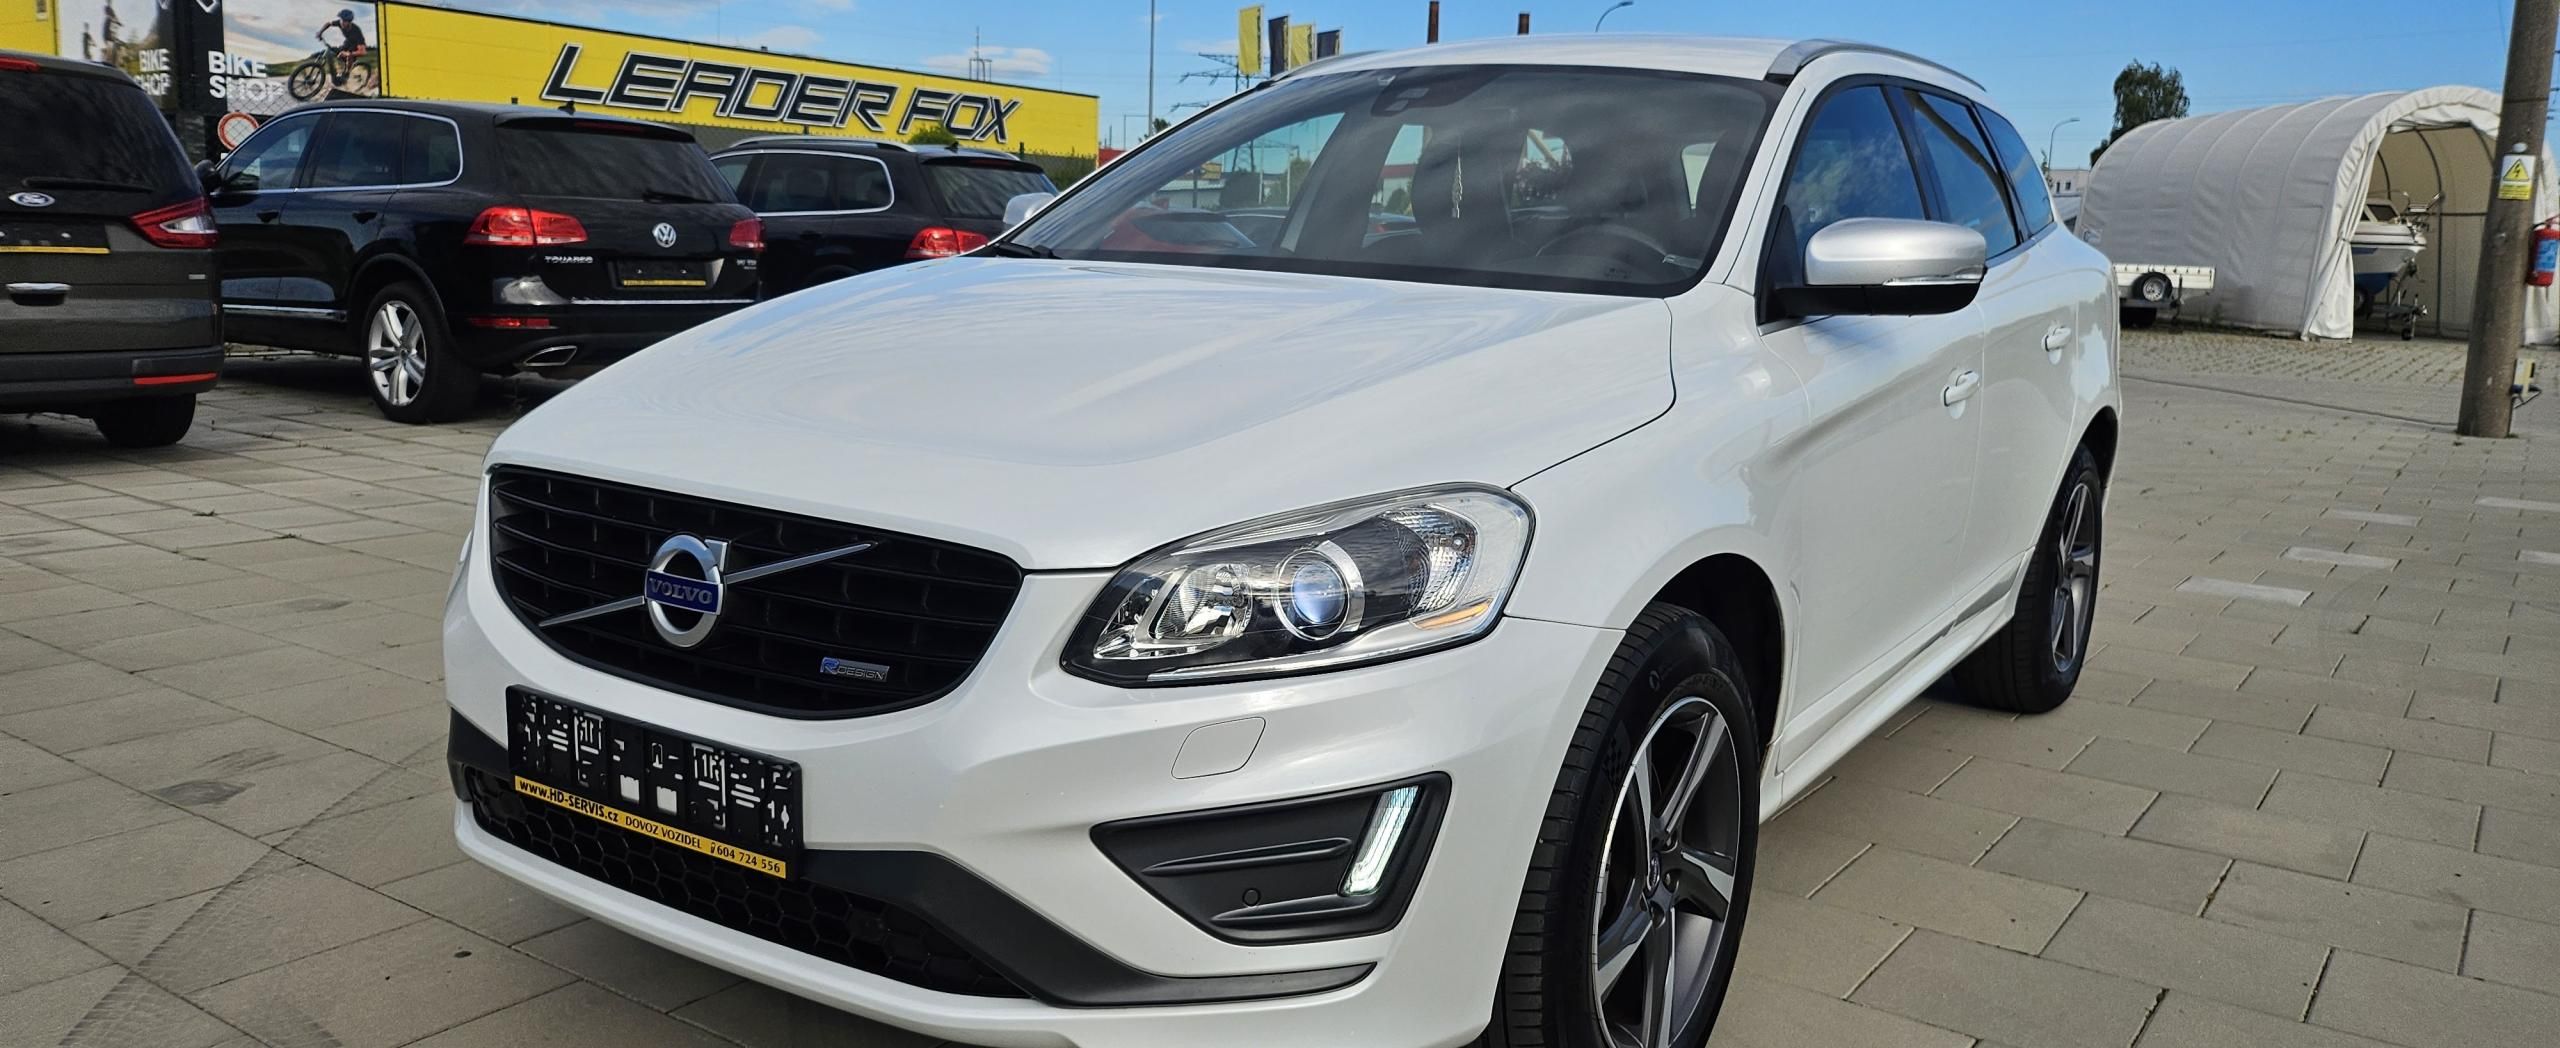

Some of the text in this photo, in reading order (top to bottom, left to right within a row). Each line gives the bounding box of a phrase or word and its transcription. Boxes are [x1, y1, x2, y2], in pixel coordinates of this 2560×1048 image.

[138, 48, 171, 72] BIKE
[208, 50, 268, 78] BIKE
[209, 74, 285, 101] SHOP
[540, 42, 1022, 144] LEADER FOX
[649, 577, 713, 605] VOLVO
[625, 815, 659, 835] DOVOZ
[661, 826, 702, 849] VOZIDEL
[716, 847, 736, 860] 604
[739, 852, 758, 867] 724
[761, 859, 781, 874] 556
